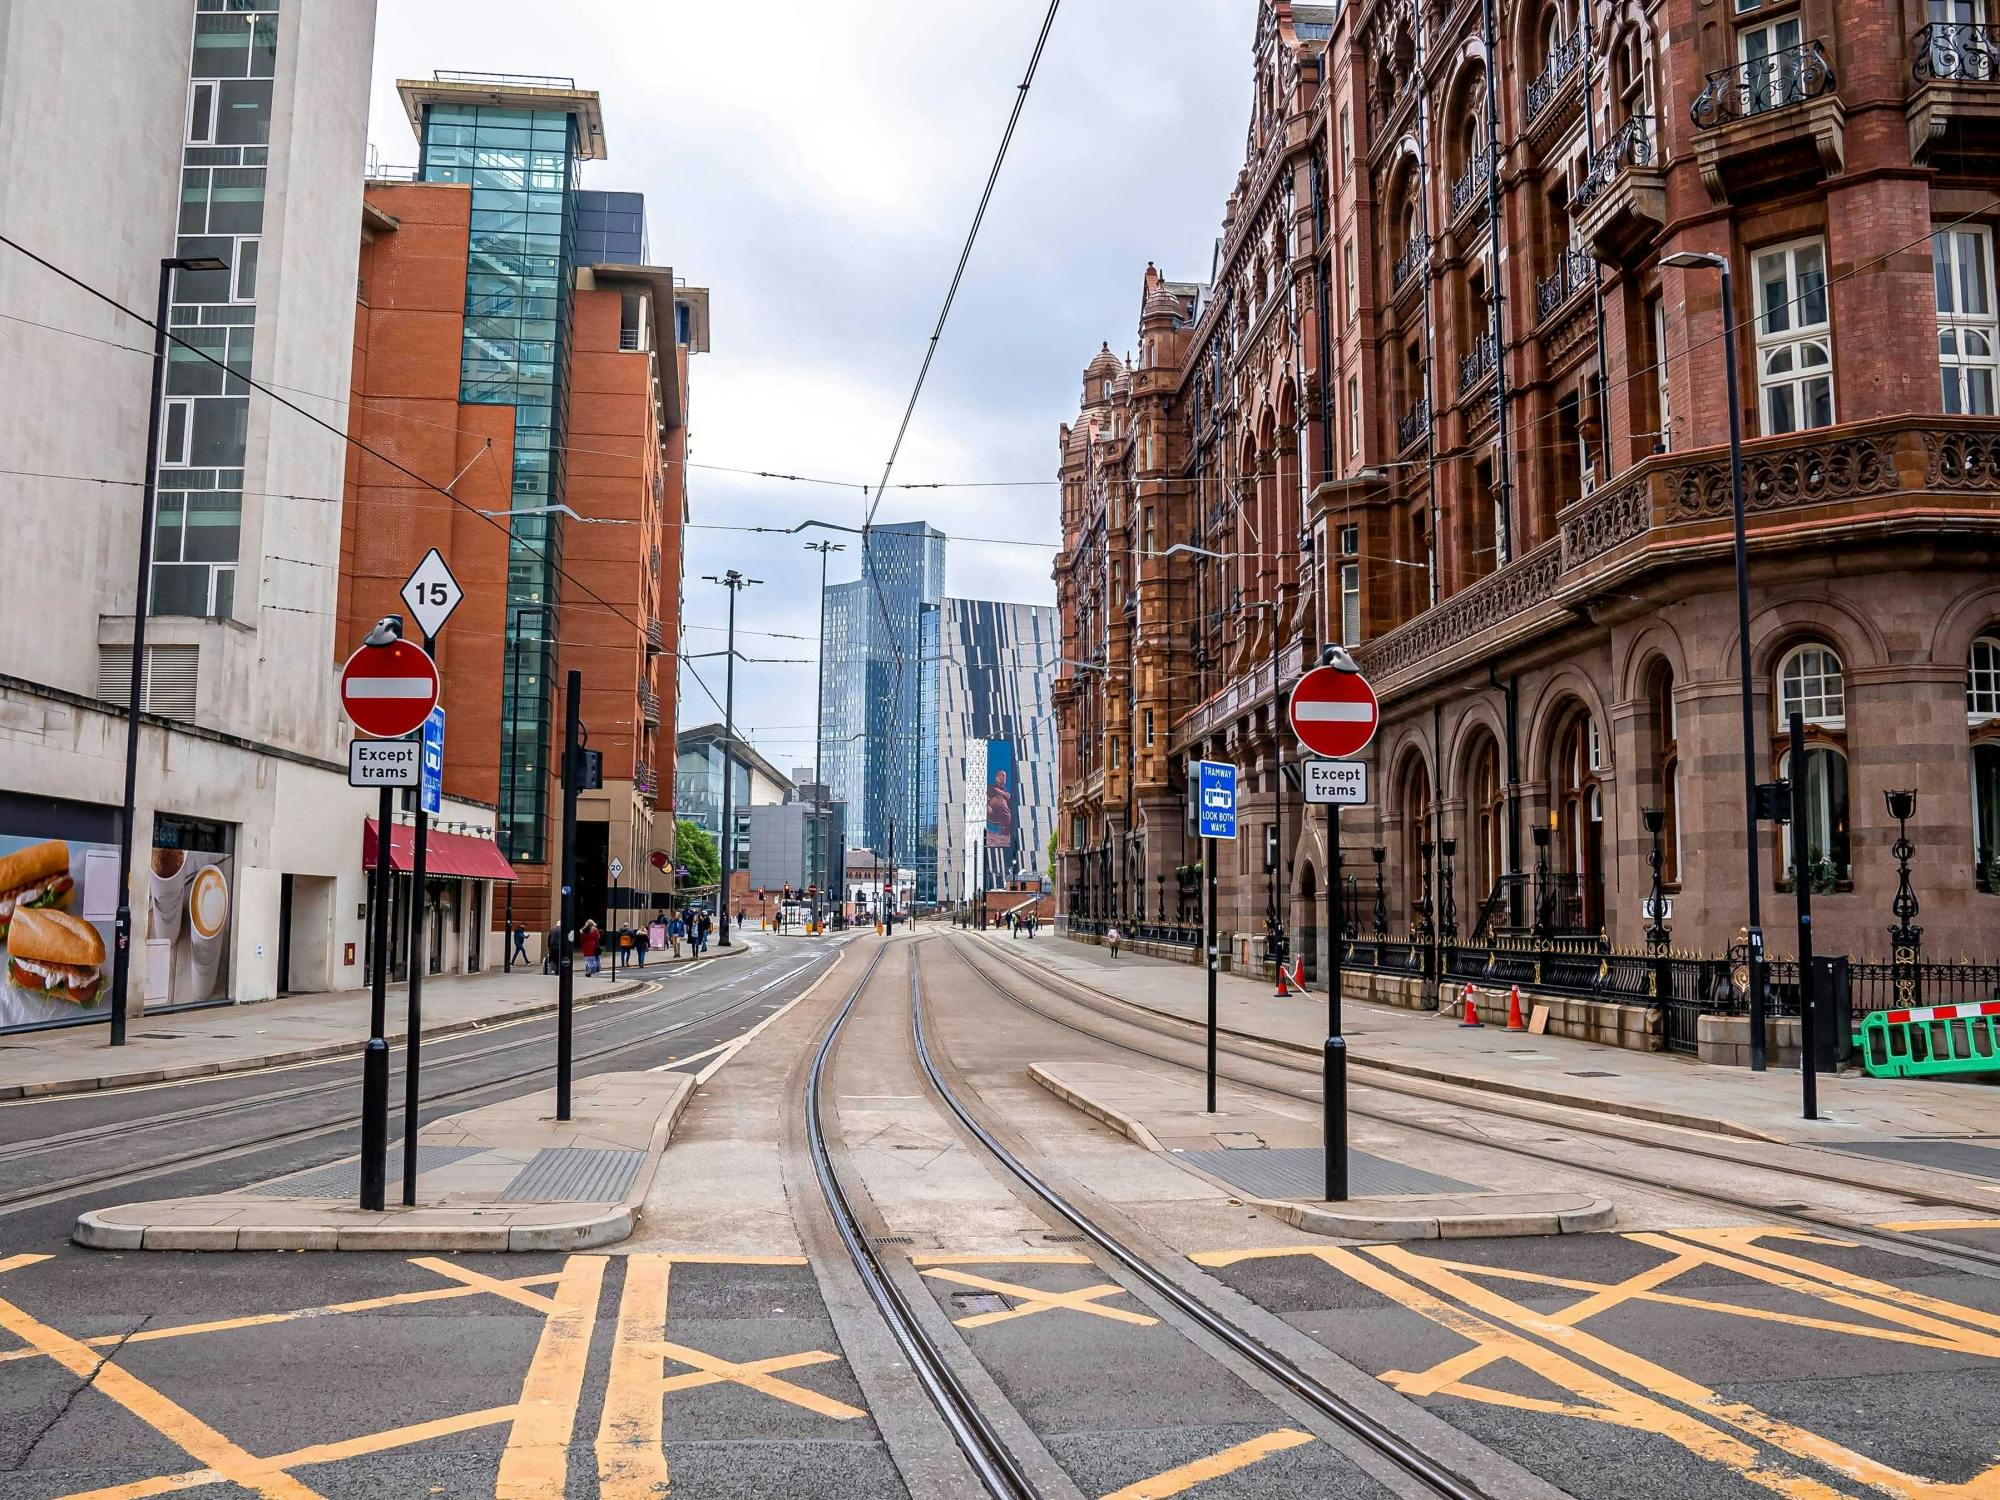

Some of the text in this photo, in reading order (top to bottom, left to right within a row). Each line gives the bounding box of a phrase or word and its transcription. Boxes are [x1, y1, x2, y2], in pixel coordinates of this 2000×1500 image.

[416, 582, 448, 606] 15
[358, 748, 413, 763] Except
[362, 765, 408, 778] trams
[1204, 766, 1232, 778] TRAMWAY
[1312, 767, 1360, 782] Except
[1315, 784, 1356, 796] trams
[1202, 811, 1234, 822] LOOK BOTH
[1210, 823, 1227, 833] WAYS
